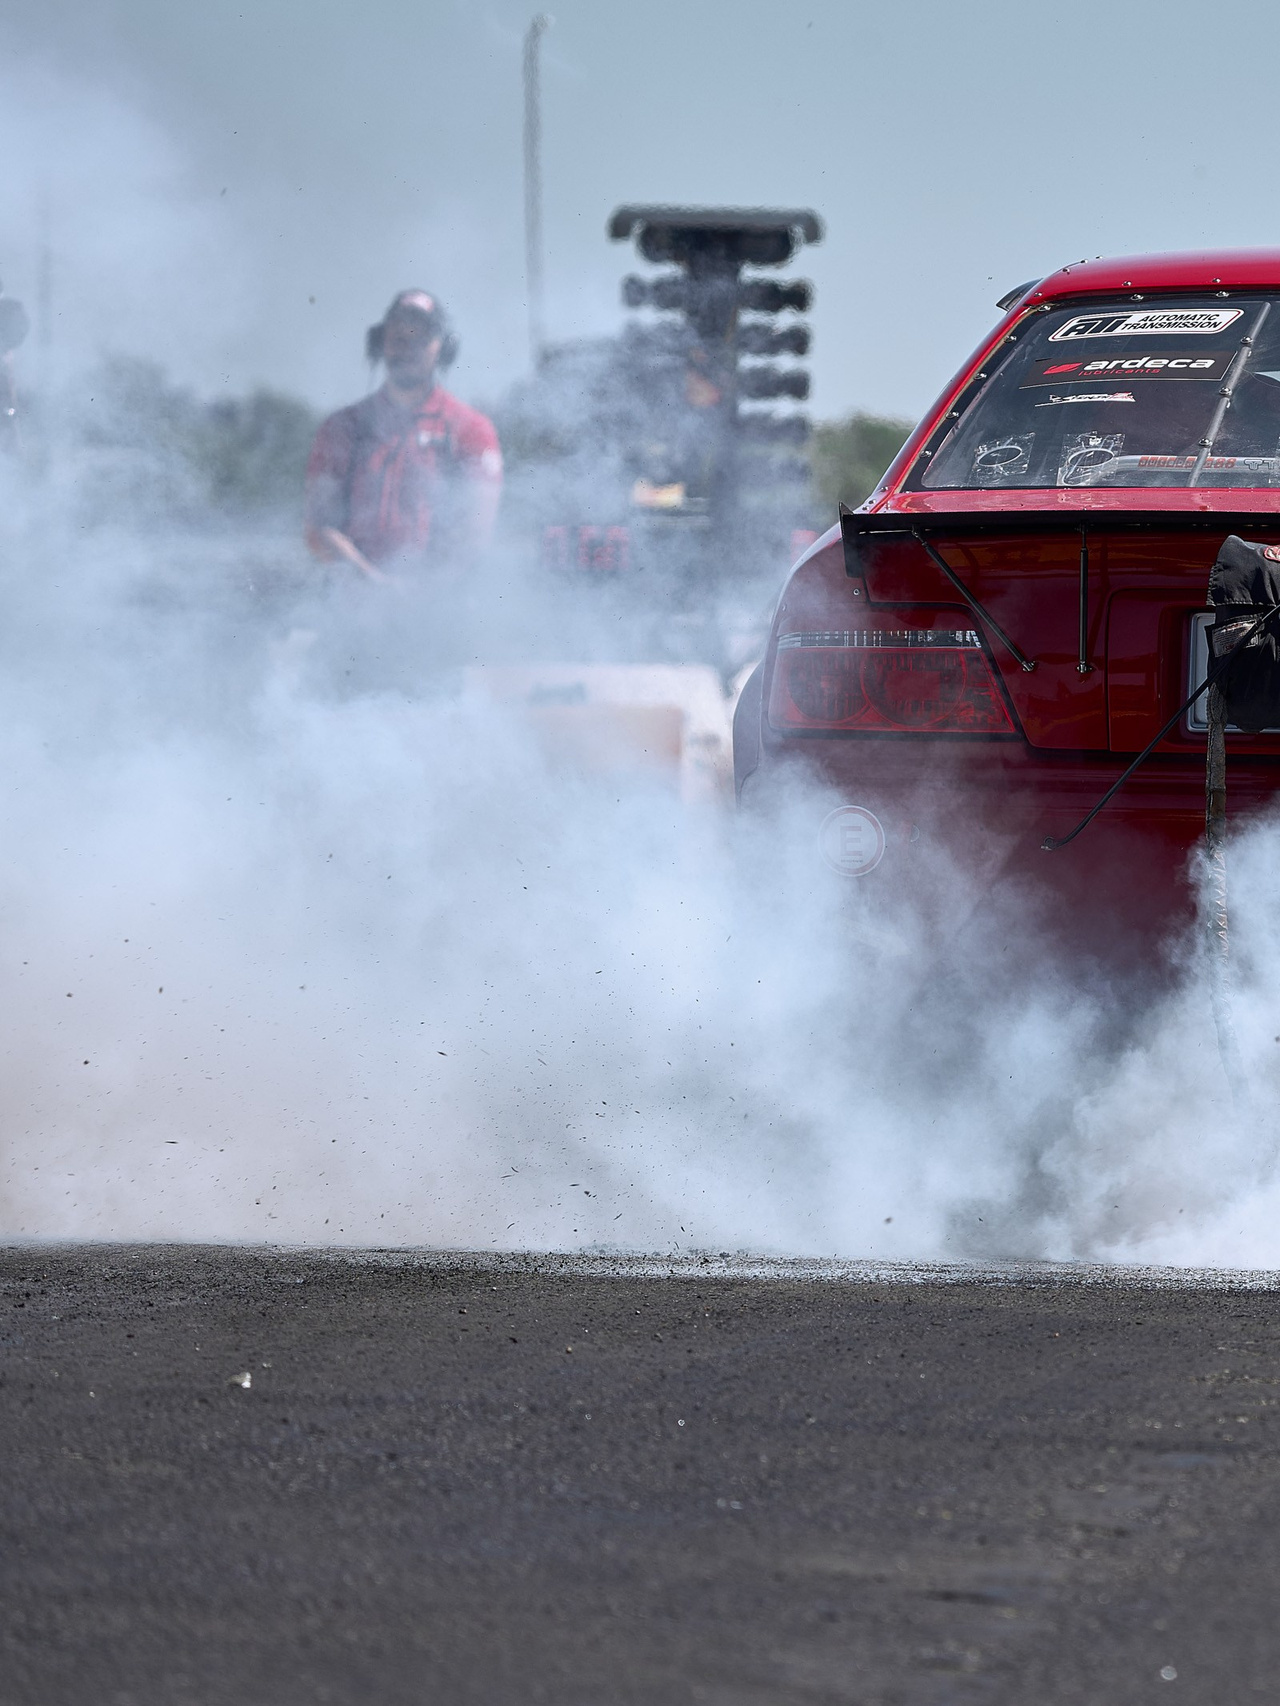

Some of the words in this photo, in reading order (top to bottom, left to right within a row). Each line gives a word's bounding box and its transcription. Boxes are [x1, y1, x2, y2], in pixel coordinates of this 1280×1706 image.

[1138, 313, 1220, 323] AUTOMATIC
[1121, 321, 1223, 331] TRANSMISSION
[1083, 356, 1216, 371] ardeca
[1078, 368, 1162, 377] lubricants
